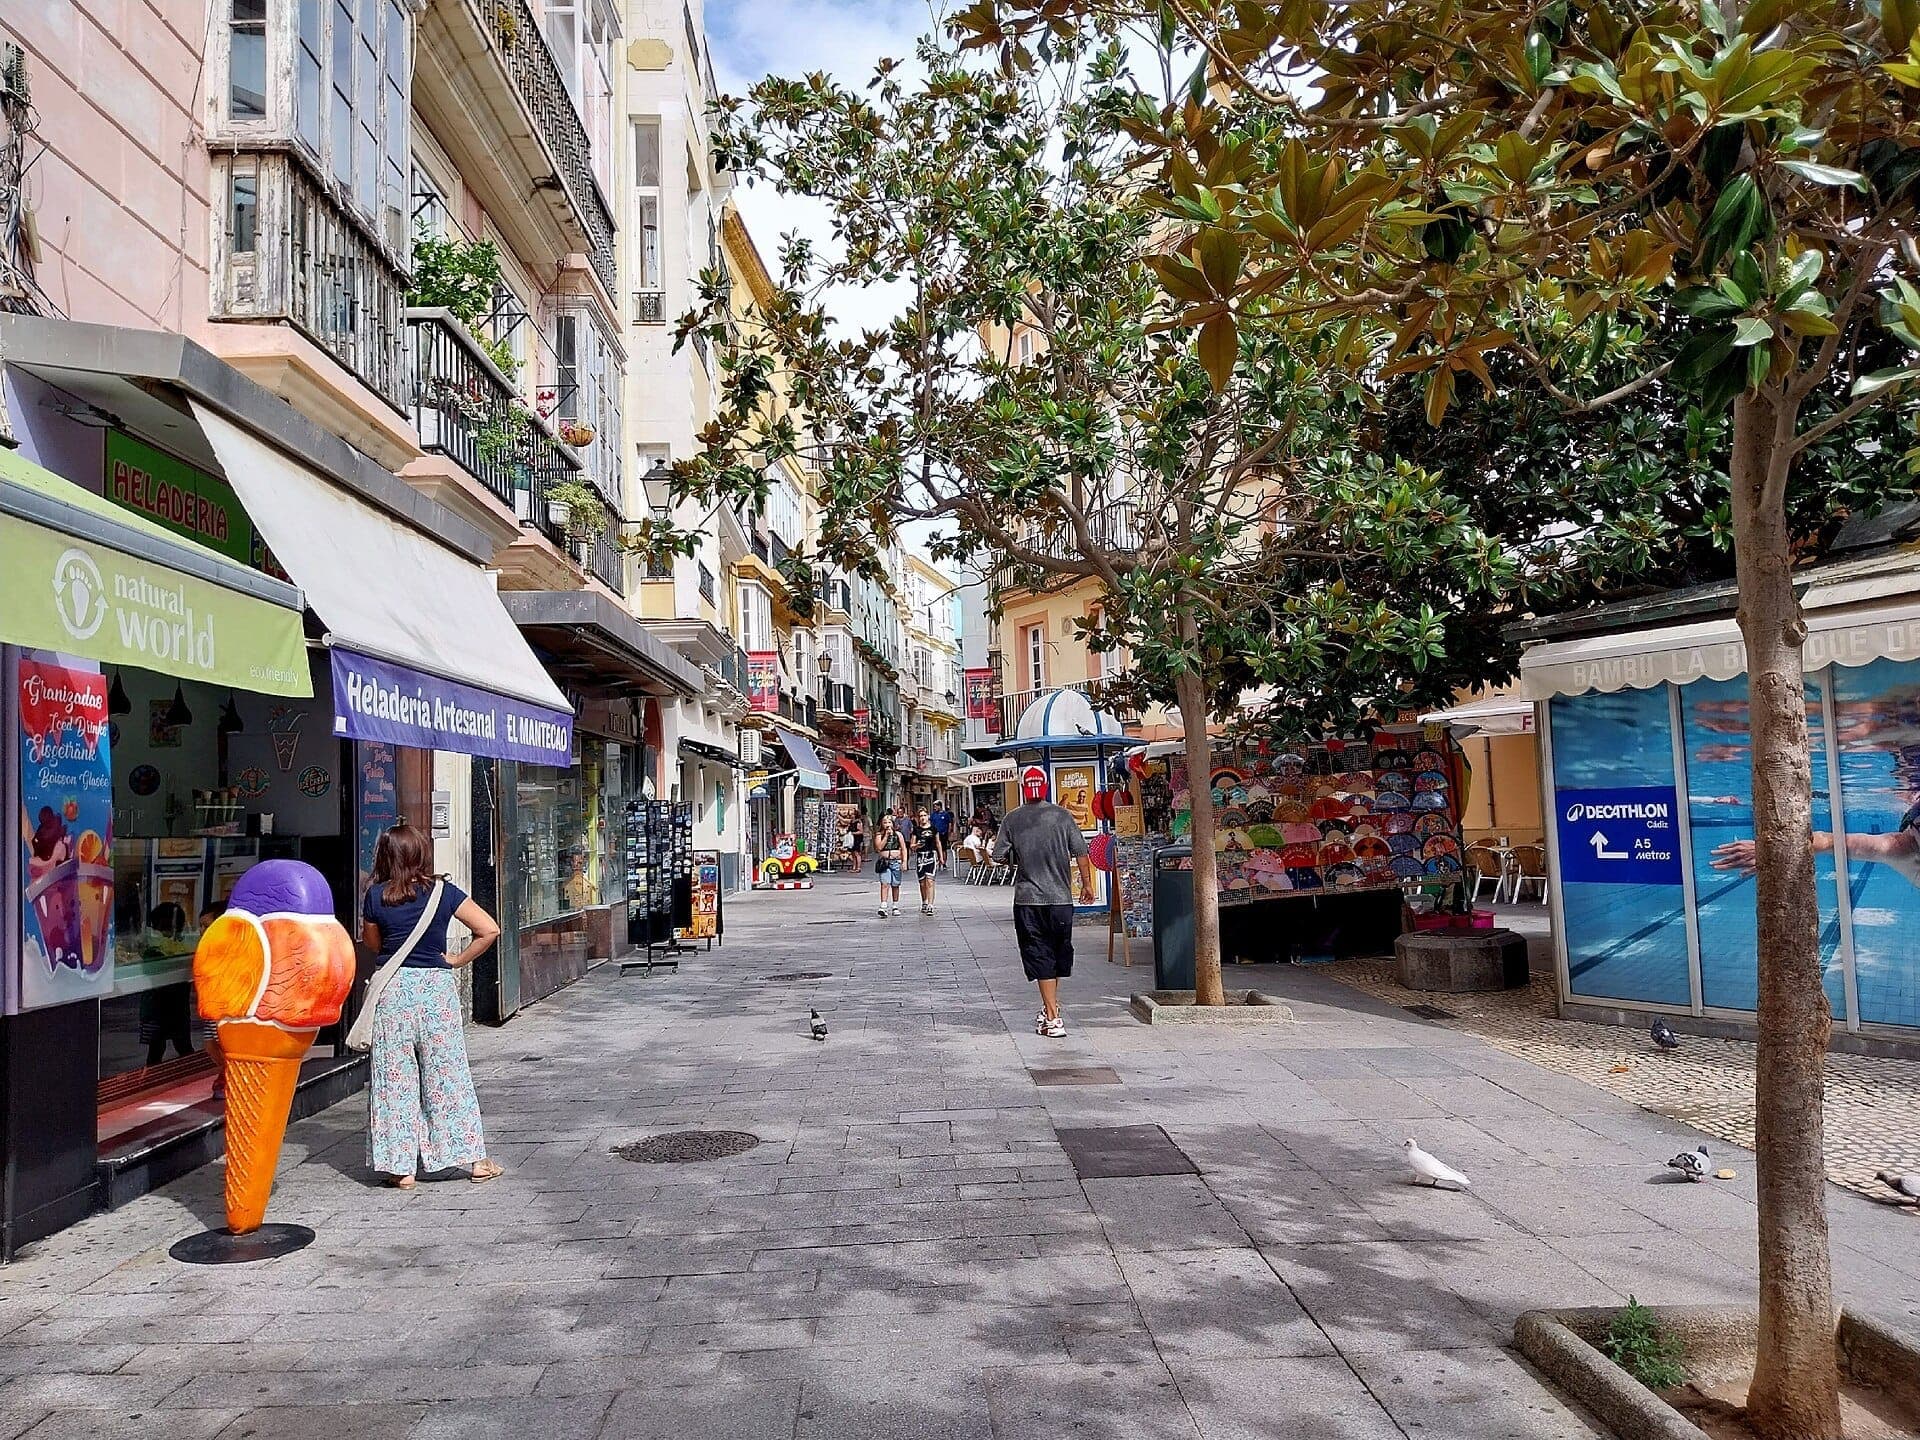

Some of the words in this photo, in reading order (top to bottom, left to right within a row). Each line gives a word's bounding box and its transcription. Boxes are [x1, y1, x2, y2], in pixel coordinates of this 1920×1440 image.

[113, 459, 229, 543] HELADERIA
[115, 574, 185, 614] natural
[117, 608, 215, 669] world
[1671, 649, 1706, 676] LA
[23, 675, 103, 713] Granizadas
[347, 672, 431, 729] Heladería
[434, 697, 496, 740] Artesanal
[507, 713, 519, 744] EL
[49, 712, 73, 734] Iced
[75, 716, 107, 737] Drinks
[38, 767, 77, 788] Boisson
[967, 769, 1015, 784] CERVECERIA
[1585, 803, 1668, 819] DECATHLON
[1646, 820, 1669, 829] Cádiz
[1634, 838, 1643, 849] A
[1644, 838, 1651, 849] 5
